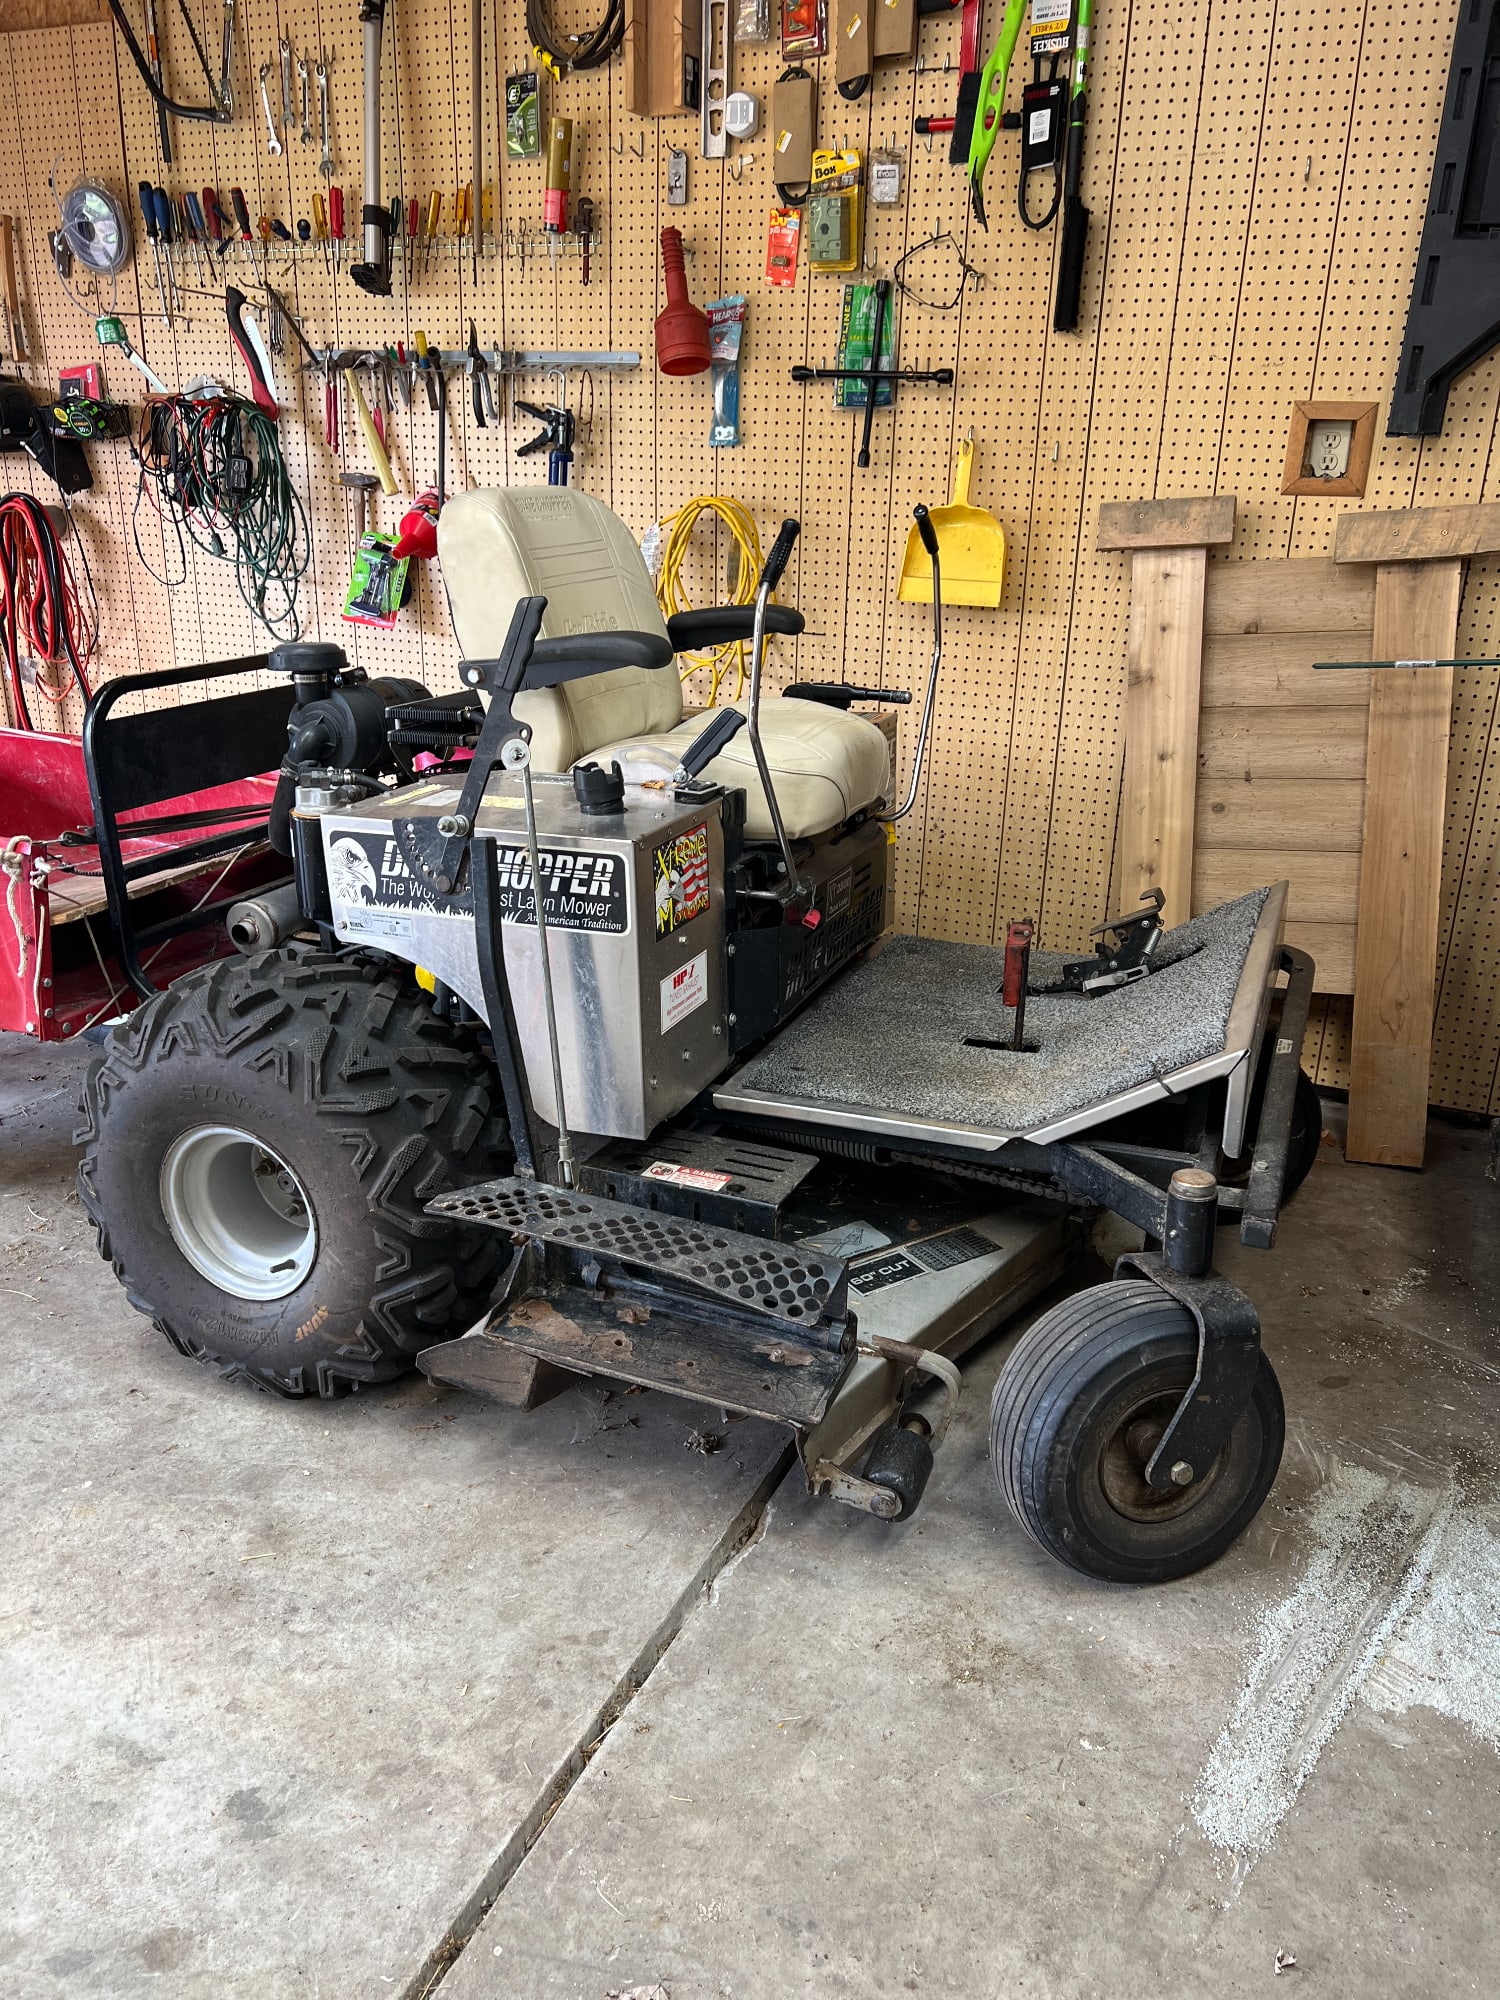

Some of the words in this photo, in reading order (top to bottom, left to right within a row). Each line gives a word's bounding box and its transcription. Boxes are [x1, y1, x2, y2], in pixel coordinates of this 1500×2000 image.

[1032, 36, 1070, 54] HUSKEE
[840, 304, 852, 350] SPLINE
[837, 351, 846, 404] SCREN
[497, 848, 615, 897] HOPPER
[380, 877, 405, 896] The
[517, 891, 555, 912] Lan
[560, 895, 612, 917] Mower
[581, 917, 622, 931] Tradition
[692, 1169, 727, 1181] DANGER
[850, 1271, 876, 1286] 60"
[879, 1260, 910, 1275] CUT
